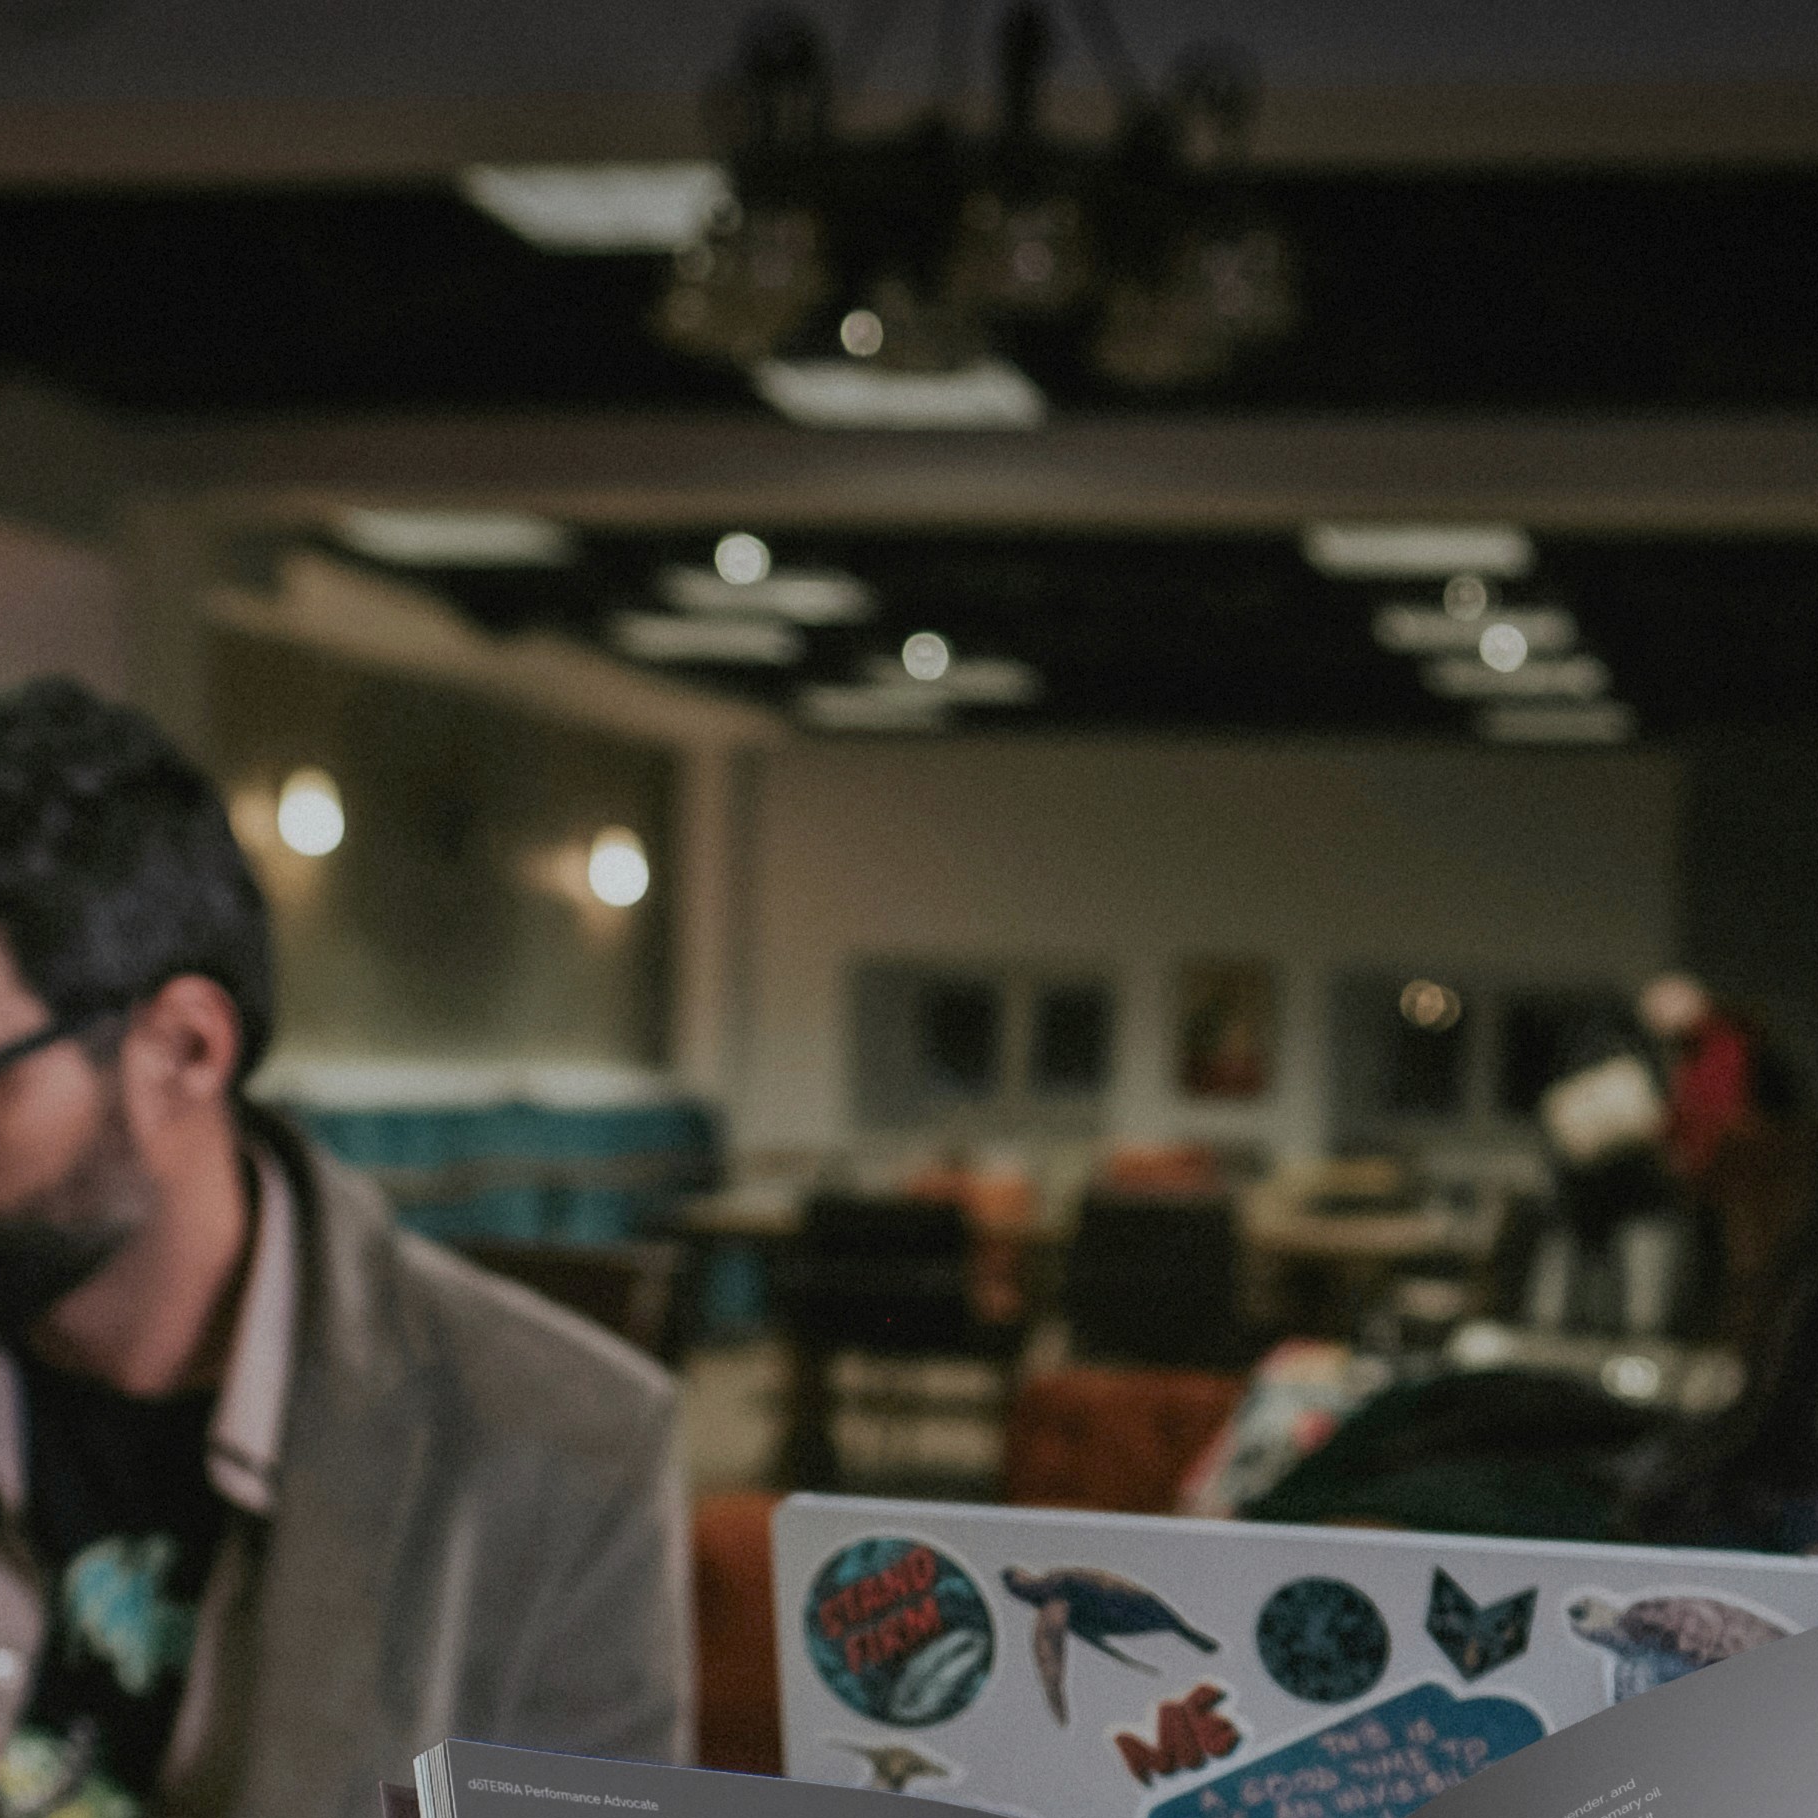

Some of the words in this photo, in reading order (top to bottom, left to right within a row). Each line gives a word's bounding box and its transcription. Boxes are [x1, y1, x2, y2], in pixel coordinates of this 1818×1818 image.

[524, 1784, 602, 1805] Performance
[604, 1794, 659, 1812] Advocate
[1609, 1778, 1637, 1799] and
